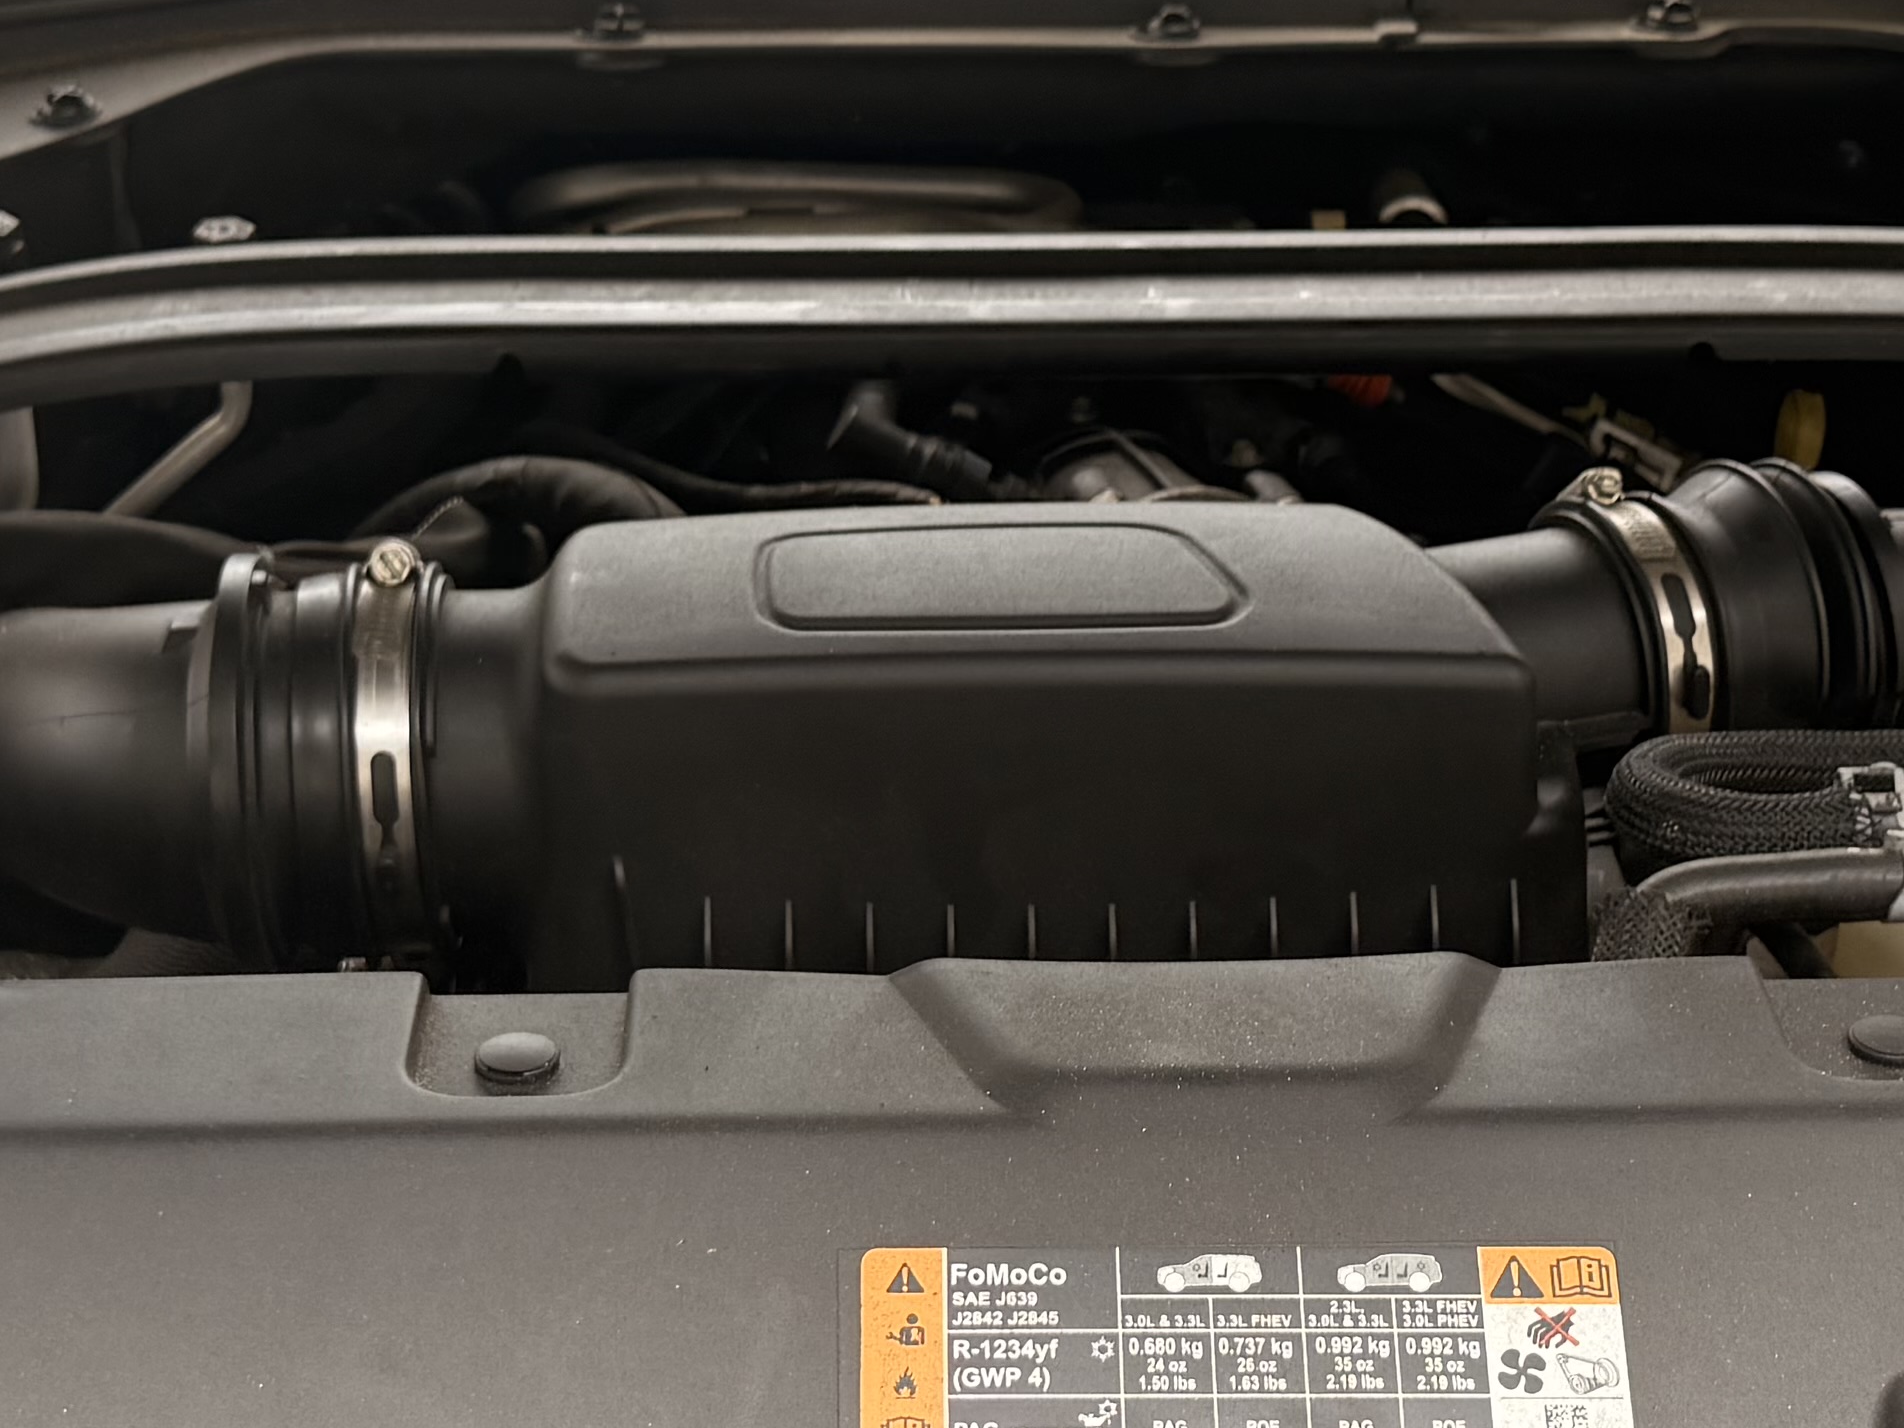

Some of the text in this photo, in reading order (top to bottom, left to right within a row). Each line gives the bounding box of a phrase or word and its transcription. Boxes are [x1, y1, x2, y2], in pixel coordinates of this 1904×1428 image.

[950, 1262, 1067, 1287] FoMoCo
[952, 1291, 1038, 1307] SAE J639
[1402, 1298, 1478, 1315] 3.3L FHEV
[951, 1310, 1059, 1326] J2842 J2845
[1124, 1314, 1206, 1329] 3.0L & 3.3L
[1216, 1314, 1293, 1329] 3.3L FHEV
[1308, 1313, 1390, 1329] 3.0L & 3.3L
[1402, 1313, 1480, 1329] 3.0L PHEV
[952, 1338, 1059, 1364] R-1234yf
[1128, 1336, 1204, 1360] 0.680 kg
[1218, 1336, 1293, 1360] 0.737 kg
[1315, 1335, 1391, 1359] 0.992 kg
[1405, 1336, 1481, 1360] 0.992 kg
[1146, 1357, 1188, 1374] 24 oz
[1236, 1356, 1278, 1373] 26 oz
[1334, 1355, 1375, 1373] 35 oz
[1424, 1356, 1466, 1373] 35 oz
[952, 1366, 1051, 1393] (GWP 4)
[1138, 1374, 1197, 1392] 1.50 lbs
[1229, 1374, 1288, 1392] 1.63 lbs
[1326, 1373, 1385, 1391] 2.19 lbs
[1416, 1374, 1476, 1391] 2.19 lbs
